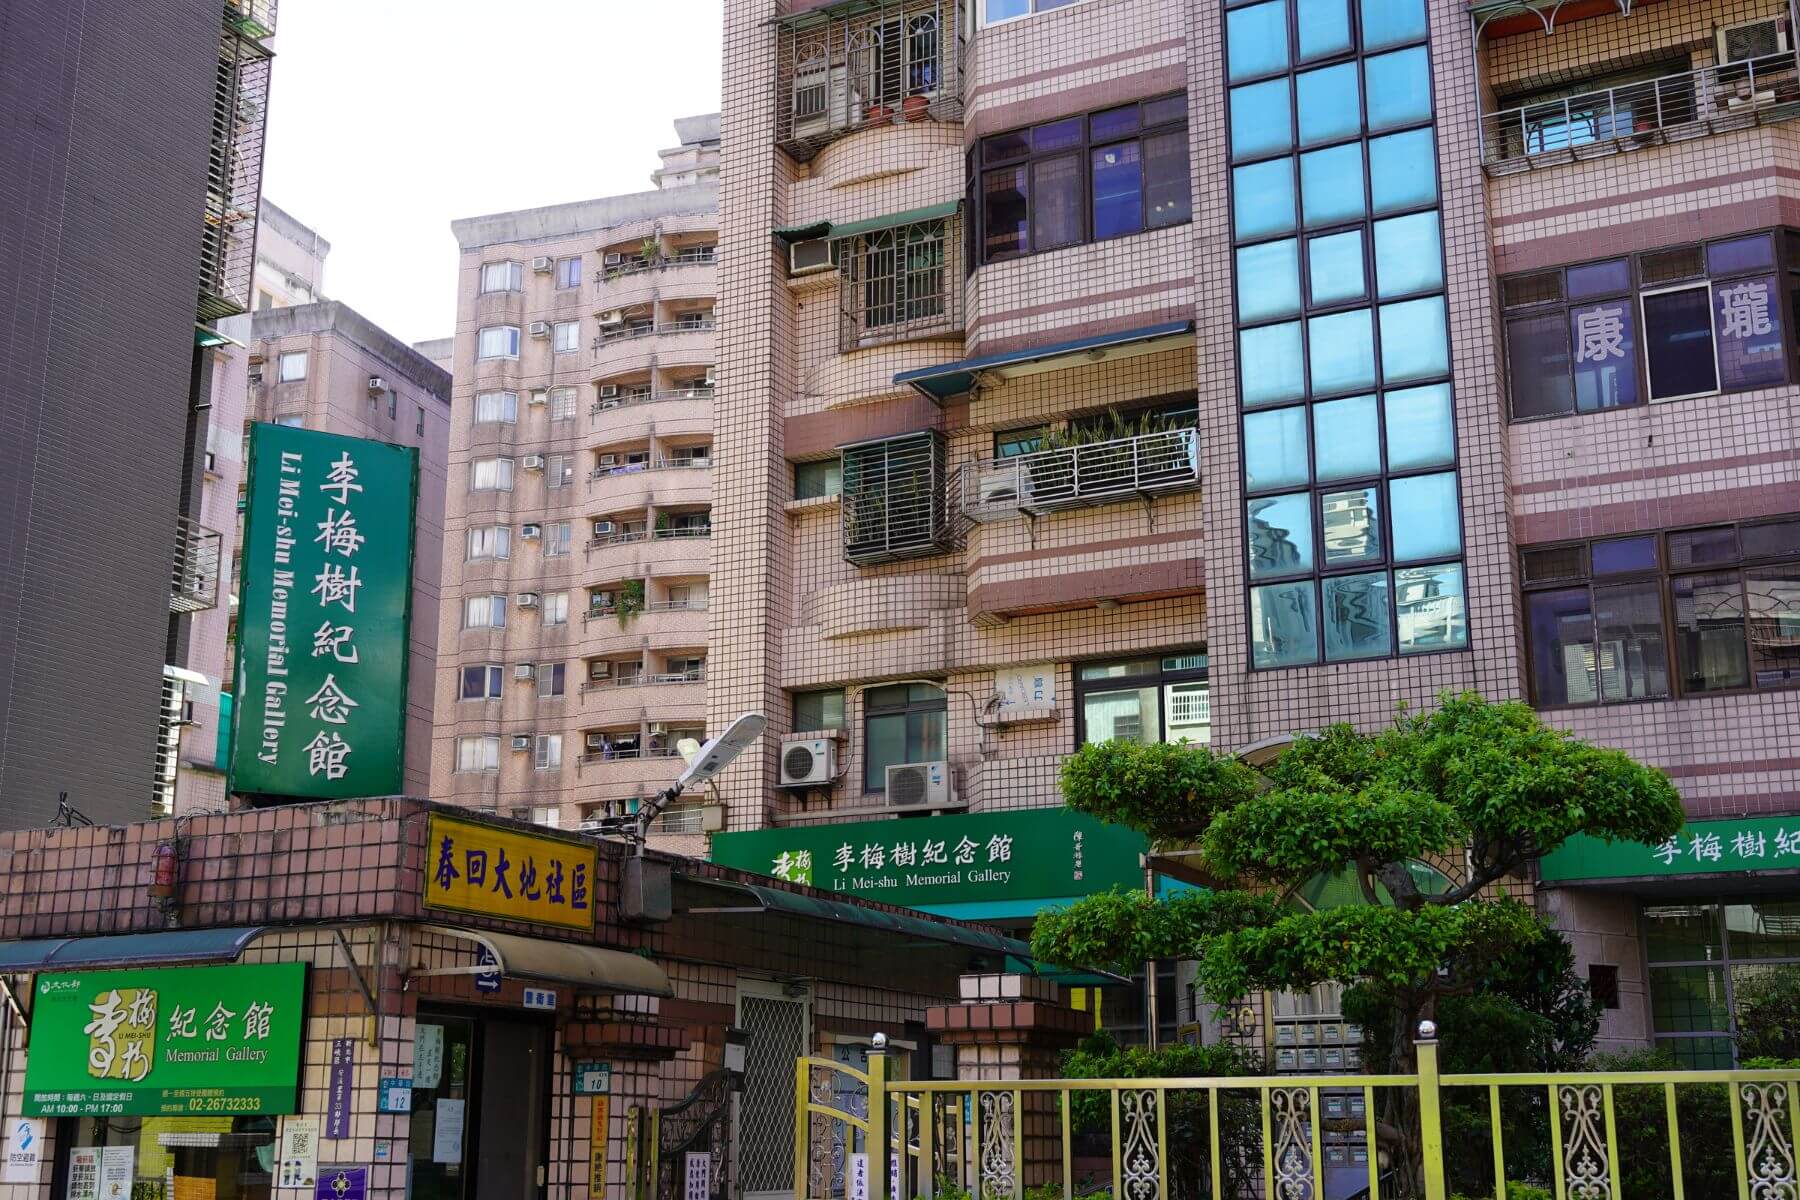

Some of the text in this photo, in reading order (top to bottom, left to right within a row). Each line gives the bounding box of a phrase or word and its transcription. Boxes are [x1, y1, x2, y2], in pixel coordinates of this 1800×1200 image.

[1576, 307, 1625, 363] 康
[257, 451, 303, 766] Li Mei-shu Memorial Gallery
[302, 451, 365, 781] 李梅樹紀念館
[832, 834, 1014, 872] 李梅樹紀念館
[433, 835, 588, 910] 春回大地社區
[834, 868, 1011, 891] Li Mei-shu Memorial Gallery
[167, 1000, 275, 1042] 紀念館
[1227, 1006, 1256, 1037] 10
[165, 1046, 269, 1065] Memorial Gallery
[592, 1079, 601, 1091] 10
[41, 1105, 54, 1113] AM
[57, 1104, 78, 1113] 10:00
[85, 1104, 98, 1113] PM
[101, 1104, 123, 1113] 17:00
[189, 1098, 261, 1111] 02-26732333
[395, 1097, 405, 1109] 12
